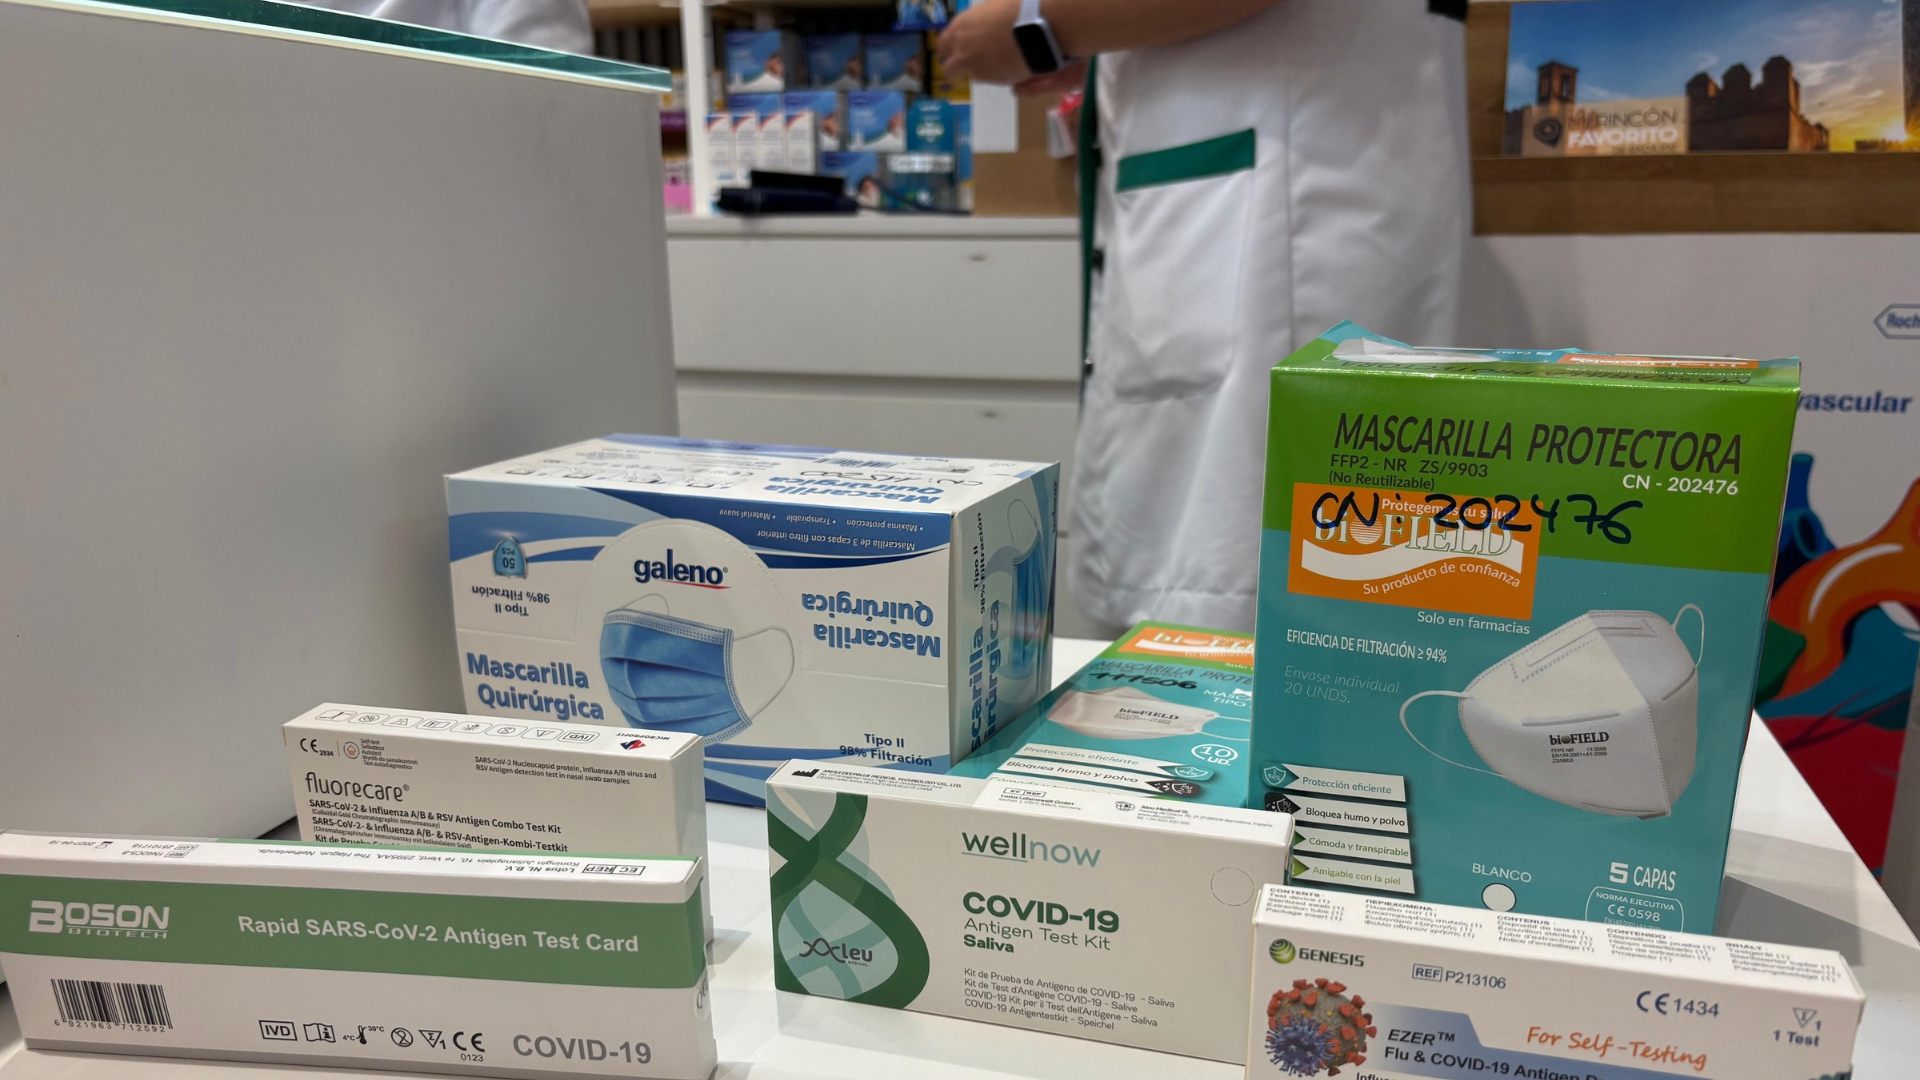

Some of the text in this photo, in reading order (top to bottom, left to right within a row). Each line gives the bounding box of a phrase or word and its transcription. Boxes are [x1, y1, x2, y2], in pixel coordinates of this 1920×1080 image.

[1568, 128, 1678, 147] FAVORITO
[1333, 412, 1741, 475] MASCARILLA PROTECTORA
[1330, 453, 1488, 478] FFP2 NR ZS/9903
[769, 476, 944, 494] Quirúrgica
[1329, 471, 1435, 491] (No Reutilizable)
[1622, 474, 1738, 495] CN 202476
[763, 485, 944, 504] Mascarilla
[1382, 498, 1515, 521] Protegemos tu salud
[1424, 493, 1644, 545] 202476
[719, 509, 917, 532] Máxima protección Transpirable Material suave
[757, 529, 915, 550] Mascarilla de 3 capas con filtro interior
[1363, 561, 1521, 596] Su producto de confianza
[472, 585, 550, 604] 98% Filtración
[495, 603, 529, 616] Tipo II
[802, 591, 934, 627] Quirúrgica
[1417, 610, 1530, 635] Solo en farmacias
[813, 623, 941, 658] Mascarilla
[1286, 629, 1339, 651] EFICIENCIA
[1340, 635, 1354, 652] DE
[1356, 636, 1416, 660] FILTRACIÓN
[1426, 647, 1447, 663] 94%
[467, 652, 589, 689] Mascarilla
[1096, 660, 1194, 676] MASCARILLA
[1285, 666, 1399, 694] Envase individual
[477, 683, 604, 721] Quirúrgica
[1213, 697, 1246, 706] TIPO
[1284, 682, 1350, 704] 20 UNDS.
[616, 732, 670, 741] MICROPROFIT
[864, 733, 904, 748] Tipo II
[839, 744, 932, 767] 98% Filtración
[1024, 747, 1139, 765] Protección eficiente
[1200, 746, 1231, 758] 10
[1302, 776, 1392, 794] Protección eficiente
[310, 799, 359, 812] SARS-CoV-2
[369, 806, 409, 817] Influenza
[411, 810, 426, 819] A/B
[436, 813, 453, 821] RSV
[456, 815, 490, 827] Antigen
[492, 819, 524, 830] Combo
[526, 822, 546, 832] Test
[548, 824, 561, 834] Kit
[1305, 806, 1405, 827] Bloquea humo y polvo
[961, 832, 1101, 868] wellnow
[1309, 836, 1409, 858] Cómoda y transpirable
[1312, 865, 1401, 887] Amigable con la piel
[1472, 863, 1532, 883] BLANCO
[1610, 862, 1676, 892] 5 CAPAS
[1270, 888, 1320, 897] CONTENTS
[1596, 892, 1674, 911] NORMA EJECUTIVA
[29, 900, 170, 934] BOSON
[962, 891, 1119, 933] COVID-19
[1497, 915, 1550, 925] CONTENUS
[1628, 908, 1660, 921] 0598
[68, 928, 167, 939] BIOTECH
[238, 915, 639, 952] Rapid SARS-CoV-2 Antigen Test Card
[964, 918, 1111, 951] Antigen Test Kit
[964, 934, 1014, 953] Saliva
[1607, 928, 1666, 939] CONTENIDO
[1299, 947, 1364, 967] GENESIS
[965, 967, 976, 977] Kit
[991, 972, 1021, 984] Prueba
[1036, 979, 1074, 992] Antígeno
[1077, 986, 1087, 994] de
[1091, 987, 1135, 1001] COVID-19
[1148, 996, 1175, 1008] Saliva
[1415, 966, 1506, 989] REF P213106
[965, 999, 1114, 1030] COVID-19 Antigentestkit Speichel
[1674, 997, 1720, 1017] 1434
[69, 1020, 112, 1030] 921963
[121, 1023, 165, 1033] 712592
[265, 1024, 290, 1037] IVD
[1527, 1026, 1562, 1046] For
[1773, 1030, 1820, 1046] 1 Test
[461, 1053, 484, 1062] 0123
[513, 1034, 652, 1064] COVID-19
[1384, 1047, 1409, 1061] Flu
[1414, 1050, 1425, 1063] &
[1431, 1053, 1509, 1074] COVID-19
